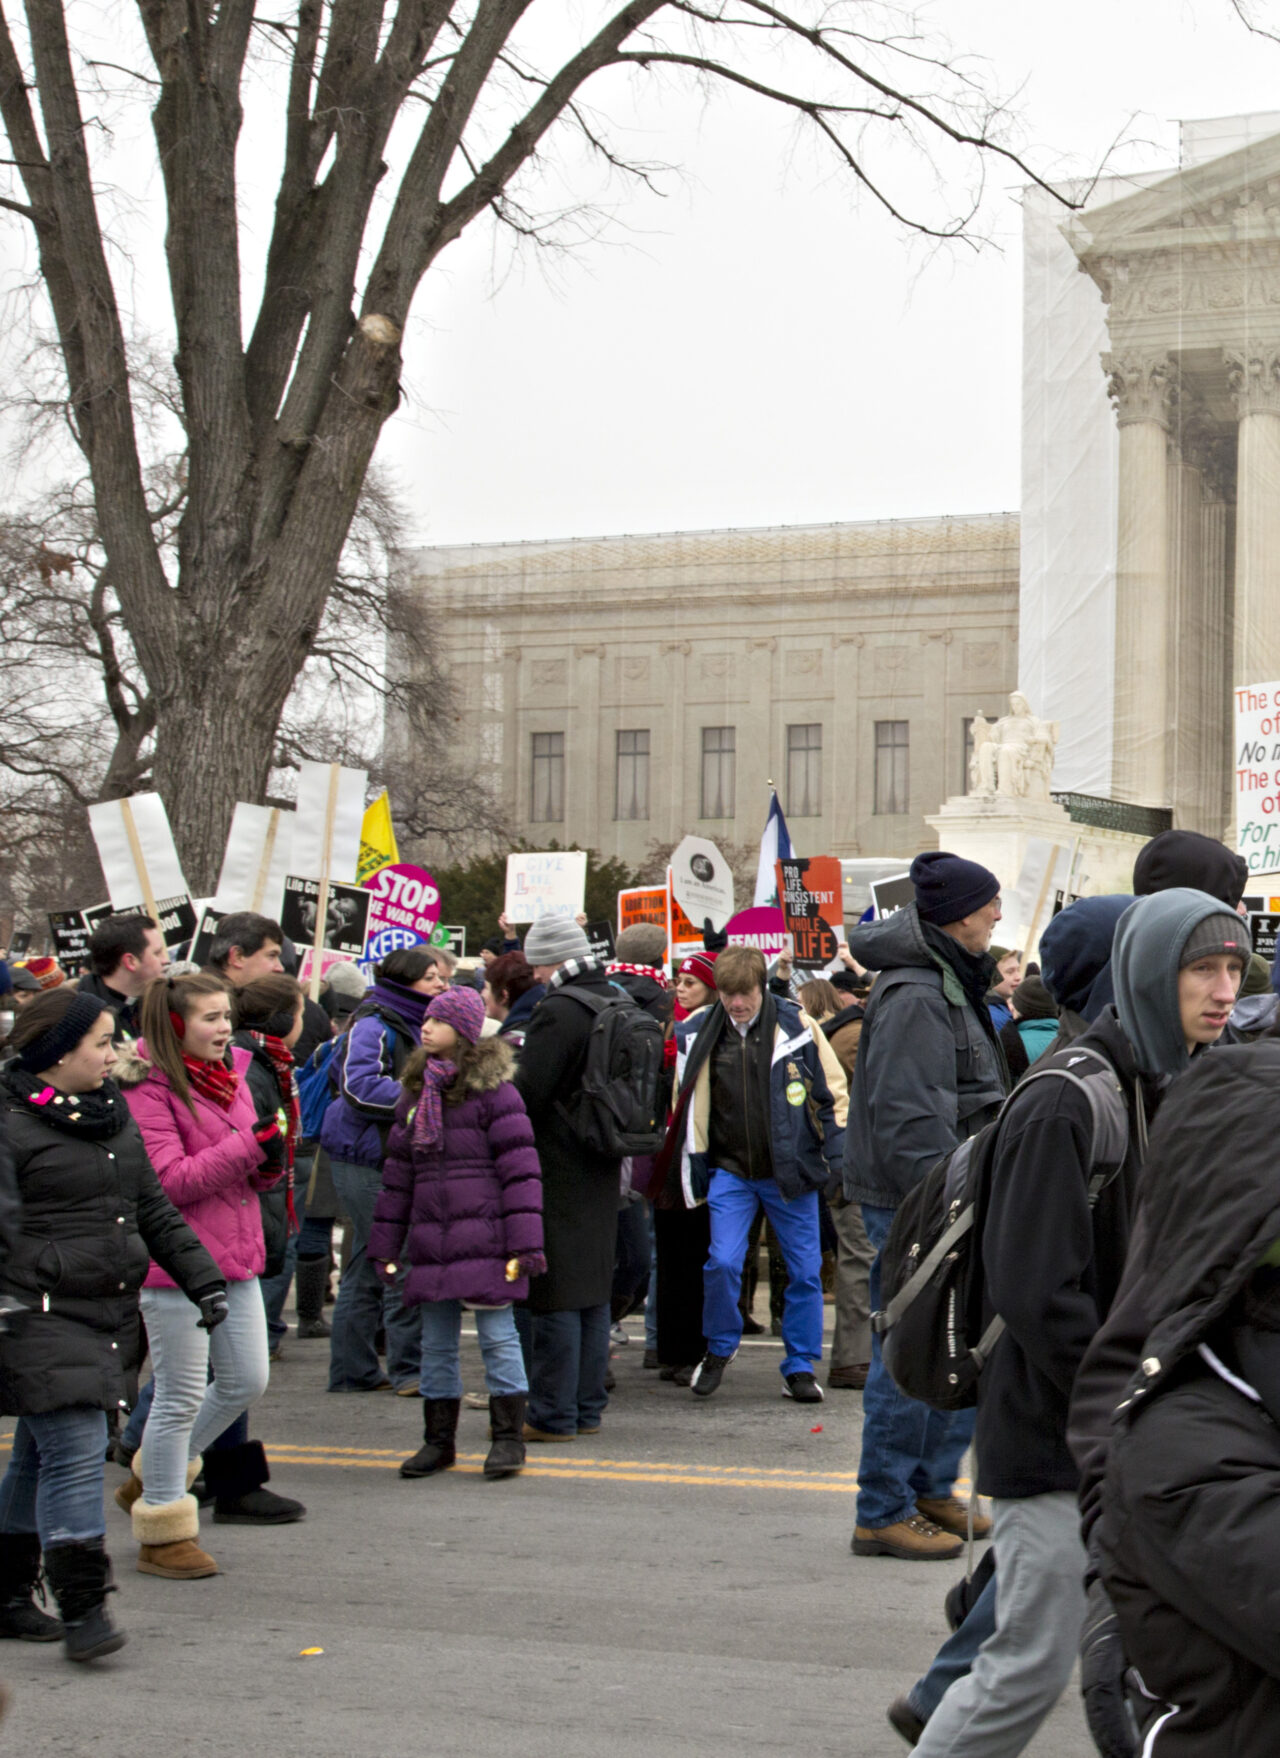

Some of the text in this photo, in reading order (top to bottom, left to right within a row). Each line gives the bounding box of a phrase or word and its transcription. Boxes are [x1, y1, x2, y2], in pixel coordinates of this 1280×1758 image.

[1235, 689, 1268, 713] The
[1238, 741, 1266, 765] No
[1236, 769, 1269, 792] The
[1239, 822, 1278, 847] for
[784, 866, 799, 879] PRO
[373, 868, 439, 915] STOP
[786, 879, 802, 891] LIFE
[782, 891, 834, 904] CONSISTENT
[386, 904, 415, 929] WAR
[415, 920, 435, 935] ON
[791, 904, 807, 917] LIFE
[788, 917, 820, 932] WHOLE
[793, 932, 833, 958] LIFE
